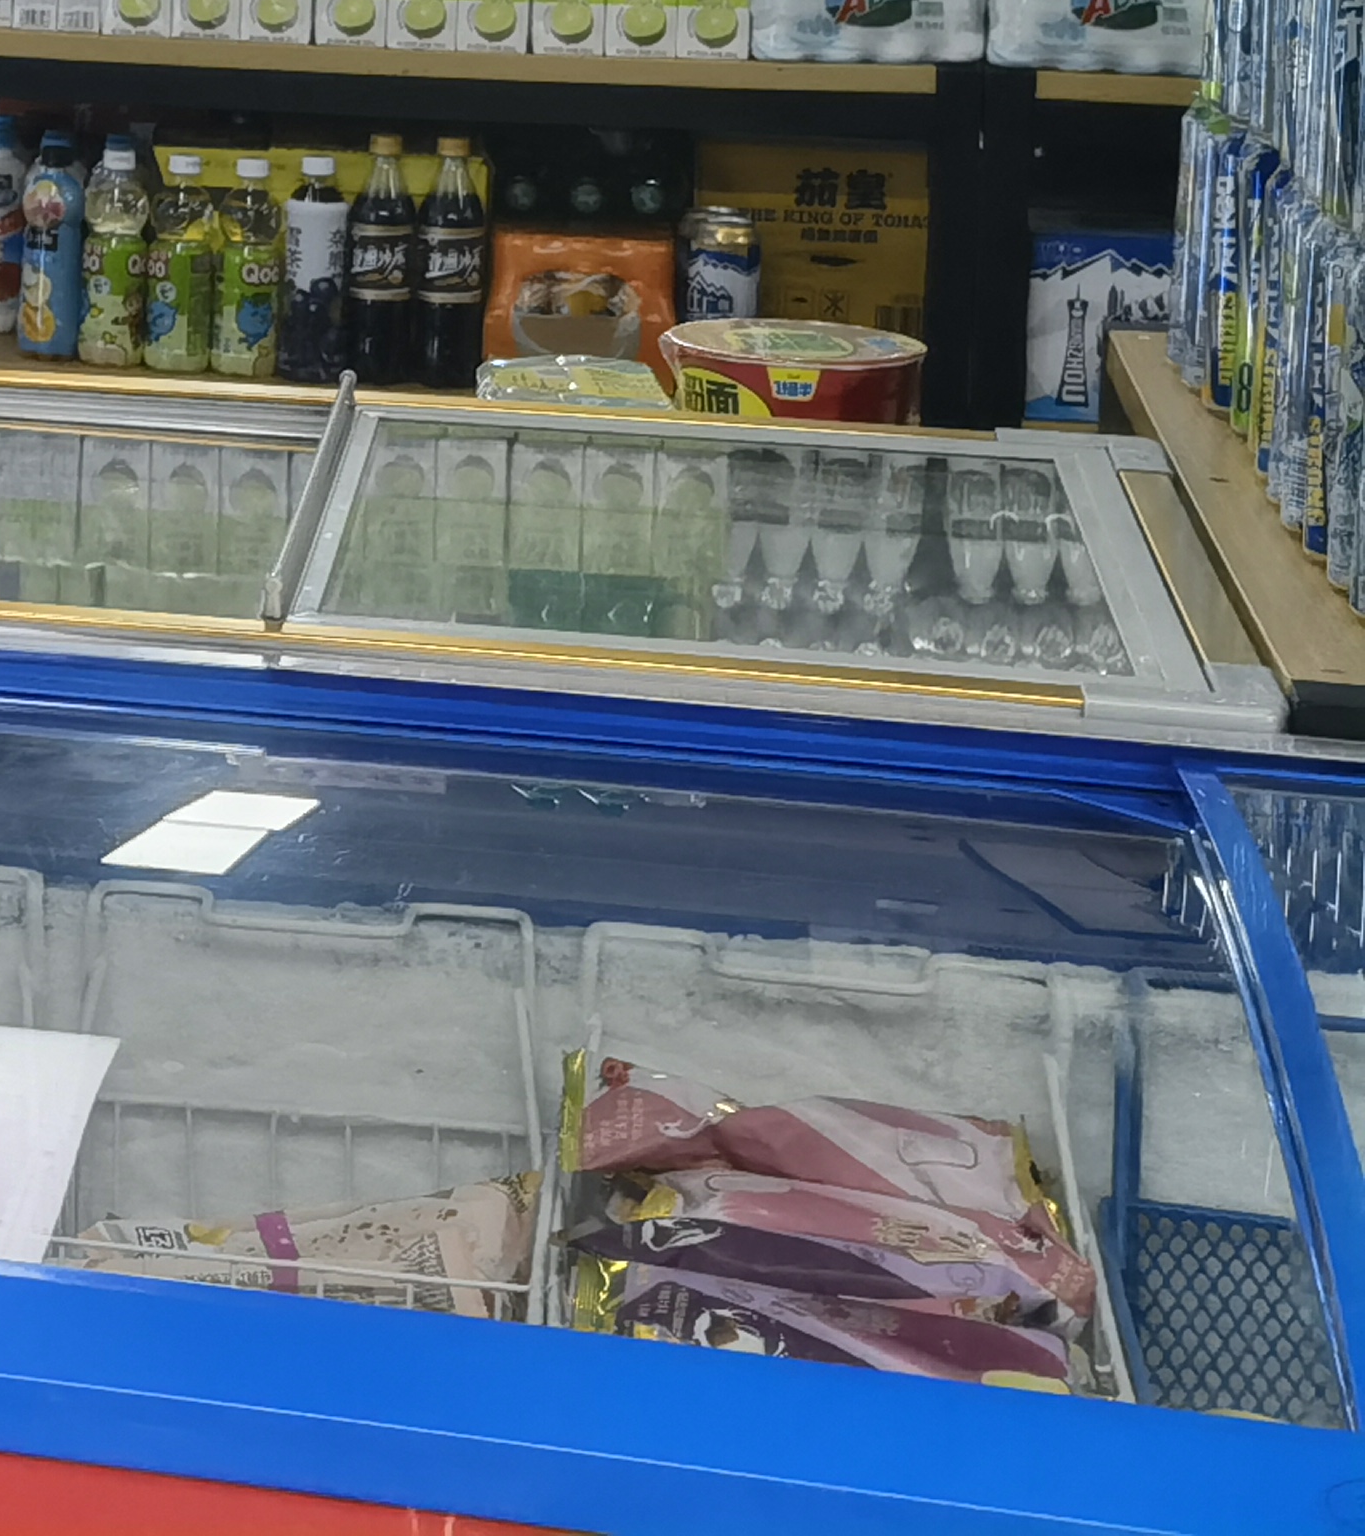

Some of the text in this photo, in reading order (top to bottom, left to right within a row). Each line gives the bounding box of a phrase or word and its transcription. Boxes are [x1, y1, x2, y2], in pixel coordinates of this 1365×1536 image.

[794, 167, 888, 211] 茄皇
[783, 210, 833, 225] KING
[839, 214, 865, 227] OF
